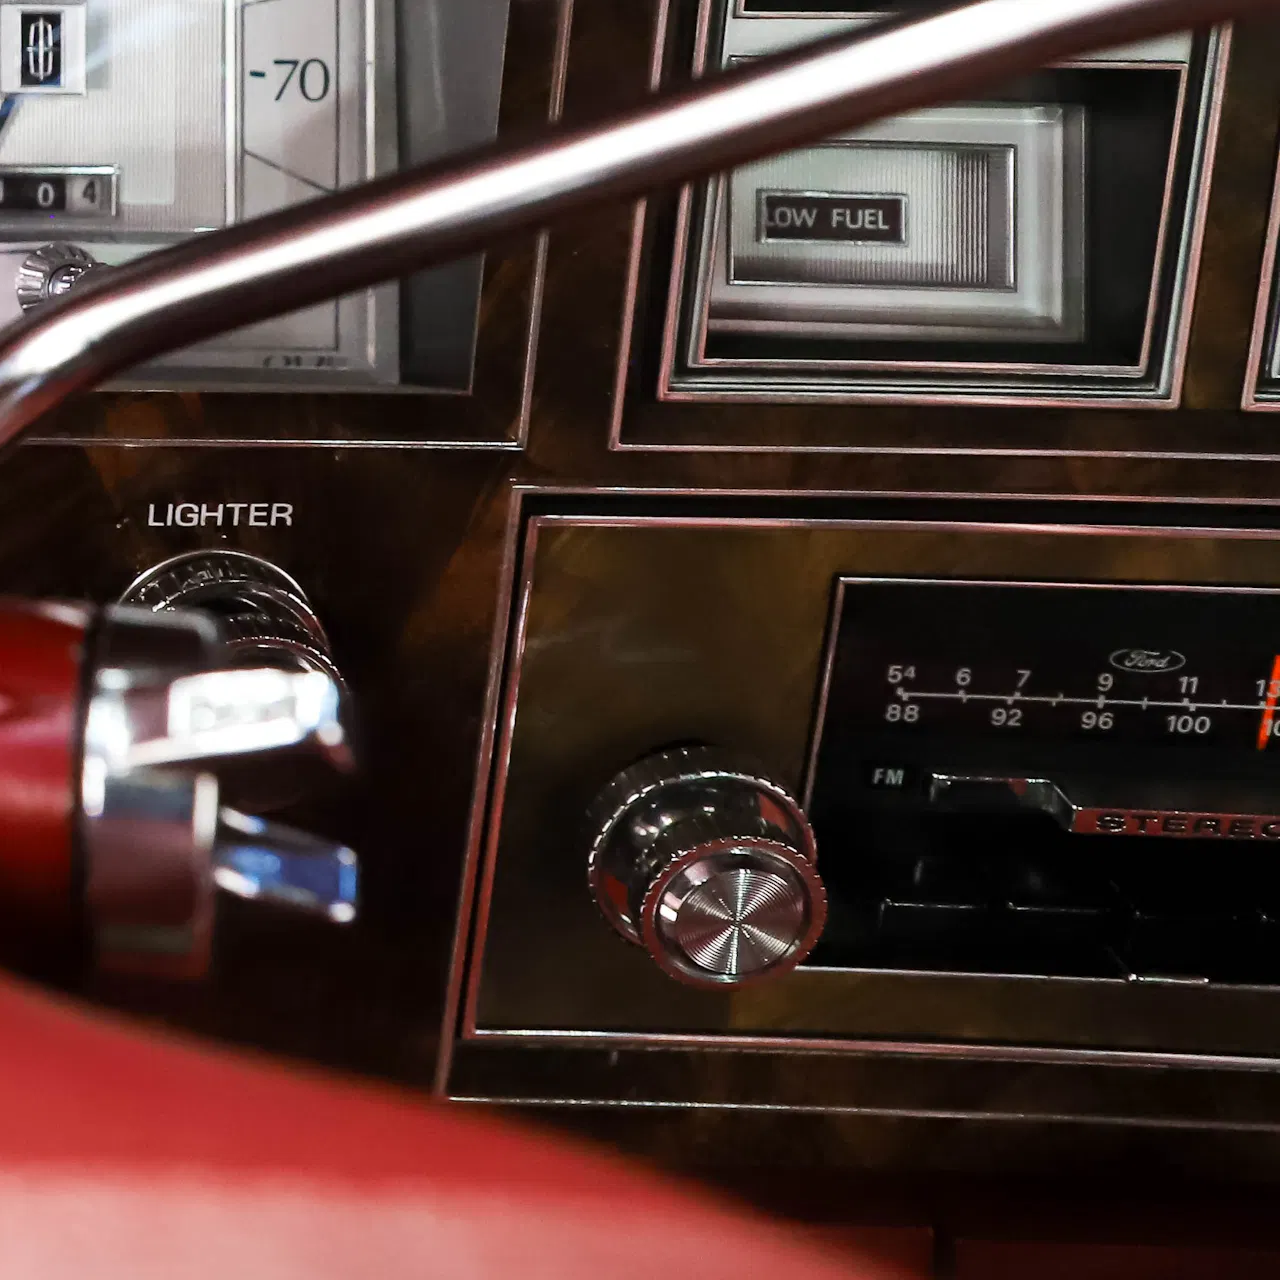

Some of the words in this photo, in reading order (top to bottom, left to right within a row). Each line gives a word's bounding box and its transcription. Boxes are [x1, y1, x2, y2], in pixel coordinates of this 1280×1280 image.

[270, 57, 332, 102] 70
[765, 206, 818, 229] LOW
[830, 207, 890, 230] FUEL
[147, 502, 294, 528] LIGHTER
[1123, 649, 1172, 669] Ford
[954, 667, 972, 687] 6
[1015, 669, 1032, 688] 7
[1096, 672, 1115, 693] 9
[1178, 675, 1200, 695] 11
[885, 703, 920, 723] 88
[990, 708, 1024, 728] 92
[1080, 711, 1115, 731] 96
[1166, 714, 1212, 734] 100
[872, 767, 905, 786] FM
